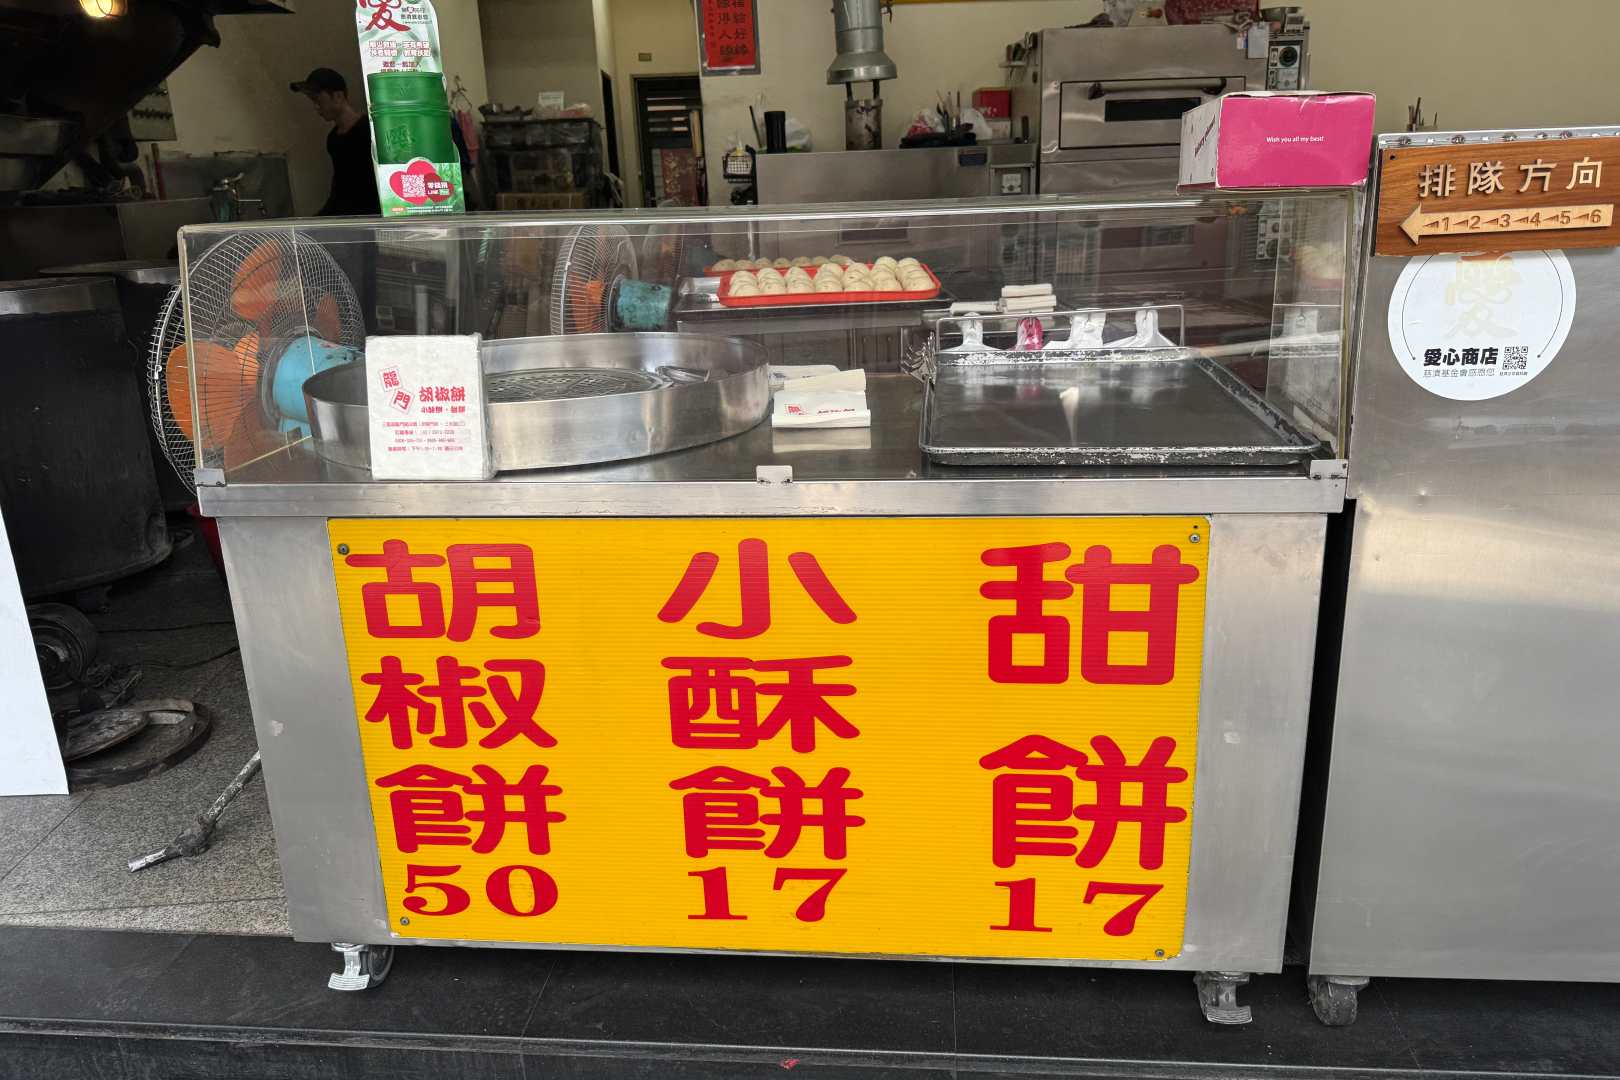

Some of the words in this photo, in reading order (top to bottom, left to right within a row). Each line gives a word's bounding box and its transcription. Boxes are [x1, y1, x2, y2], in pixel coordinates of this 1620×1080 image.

[1417, 156, 1603, 199] 排隊方向
[1441, 217, 1450, 231] 1
[1467, 215, 1481, 230] 2
[1499, 214, 1511, 228] 3
[1529, 212, 1541, 227] 4
[1559, 210, 1571, 225] 5
[1590, 209, 1602, 224] 6
[1423, 346, 1499, 367] 愛心商店
[419, 386, 466, 402] 胡椒餅
[345, 540, 566, 855] 胡椒餅
[658, 539, 865, 860] 小酥餅
[979, 542, 1199, 870] 甜餅
[403, 864, 558, 917] 50
[688, 867, 847, 922] 17
[990, 878, 1163, 936] 17
